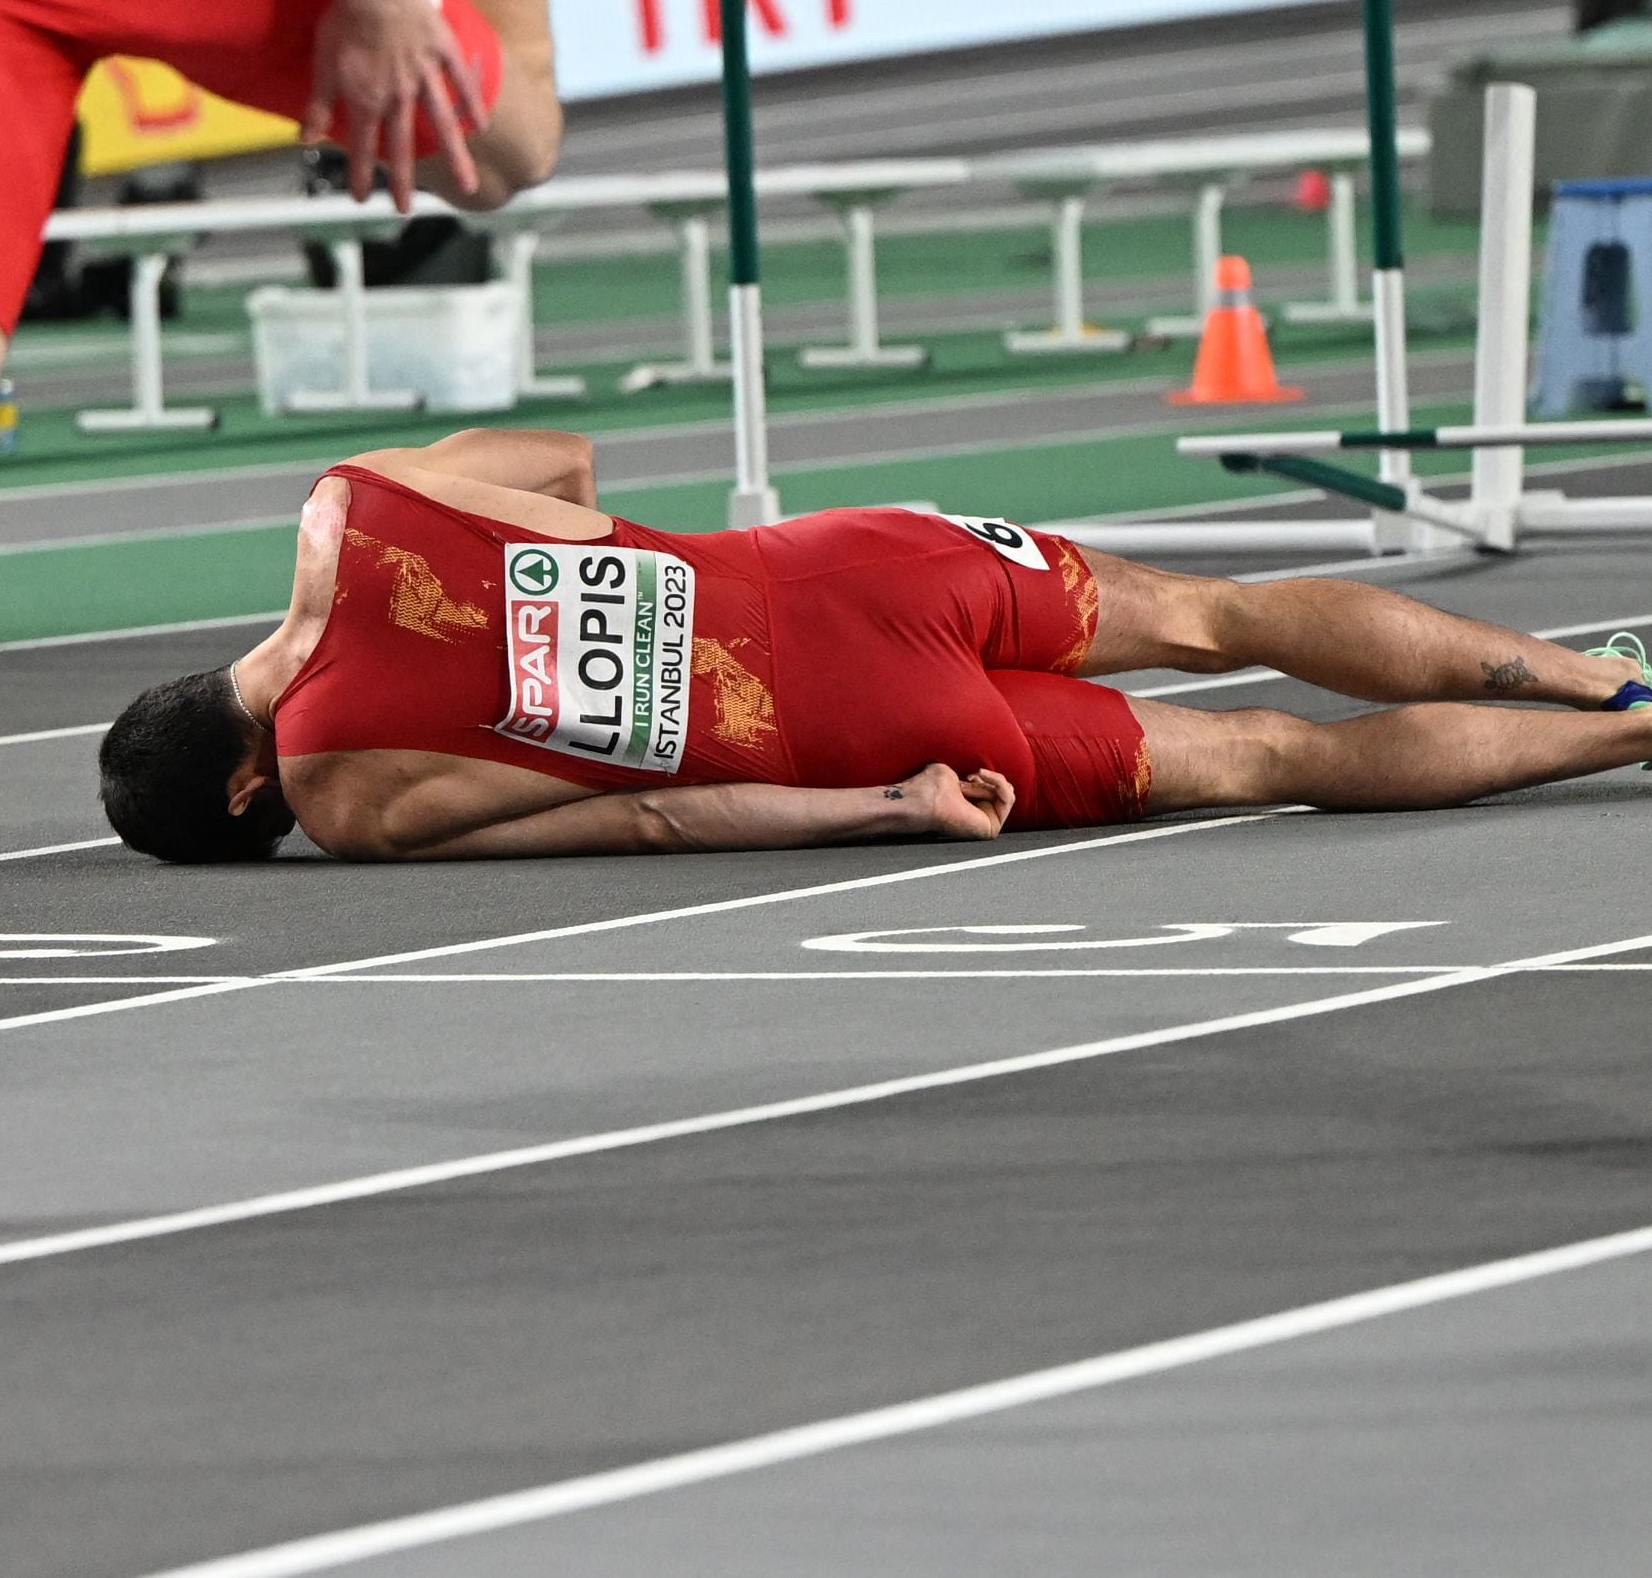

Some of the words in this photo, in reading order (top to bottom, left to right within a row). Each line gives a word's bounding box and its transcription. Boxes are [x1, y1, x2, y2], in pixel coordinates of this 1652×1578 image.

[963, 522, 1023, 549] 6
[663, 564, 687, 629] 2023
[517, 604, 553, 738] SPAR
[568, 555, 626, 756] LLOPIS
[634, 673, 653, 716] RUN
[654, 633, 684, 759] ISTANBUL
